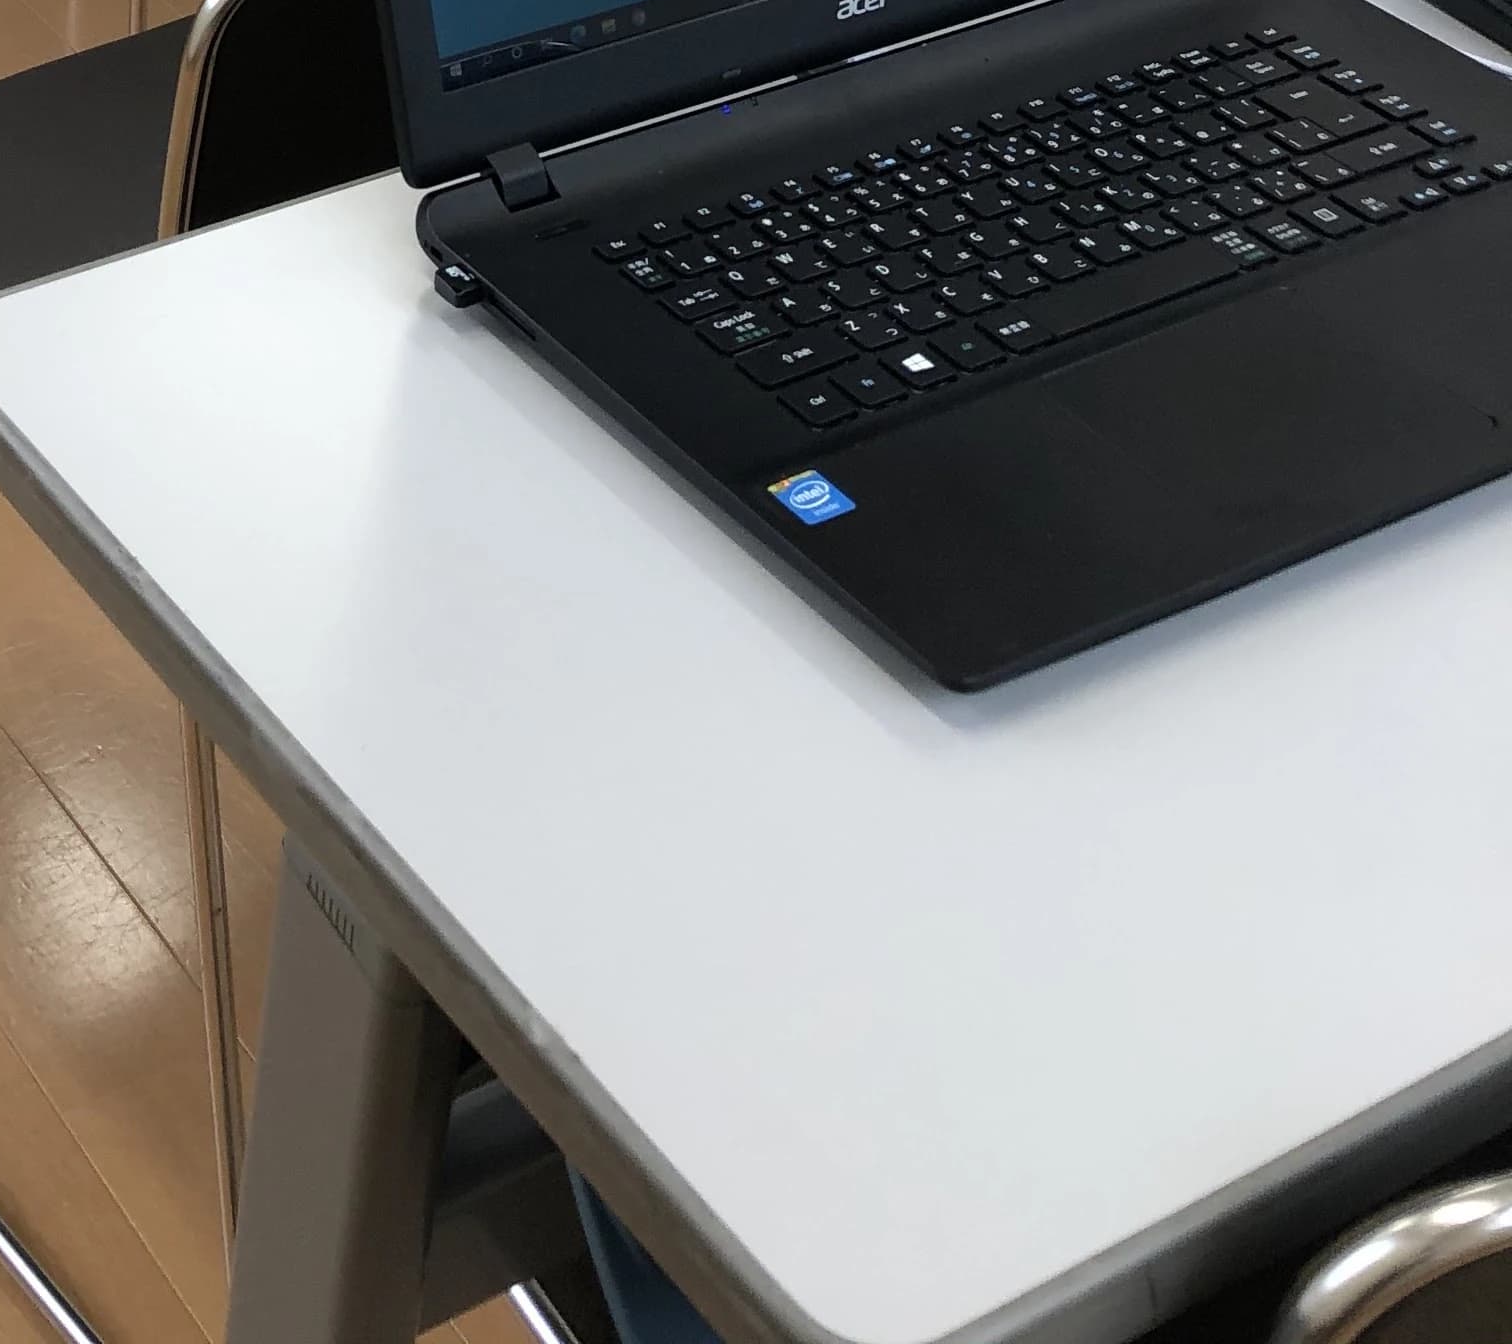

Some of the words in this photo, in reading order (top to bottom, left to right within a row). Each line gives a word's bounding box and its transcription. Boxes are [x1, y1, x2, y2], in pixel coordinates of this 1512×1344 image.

[1006, 178, 1019, 186] U
[1103, 186, 1117, 194] K
[962, 192, 973, 200] Y
[916, 208, 928, 216] T
[1014, 217, 1028, 225] H
[870, 224, 884, 232] R
[1124, 221, 1141, 231] M
[970, 233, 983, 241] G
[823, 239, 836, 248] E
[1080, 237, 1095, 247] N
[922, 249, 932, 258] F
[776, 253, 793, 263] W
[1034, 254, 1047, 263] B
[876, 266, 889, 274] D
[729, 272, 744, 280] Q
[988, 270, 1002, 279] V
[828, 282, 840, 290] S
[943, 287, 956, 295] C
[783, 298, 795, 307] A
[894, 304, 909, 313] X
[845, 321, 860, 330] Z
[794, 485, 824, 502] intel
